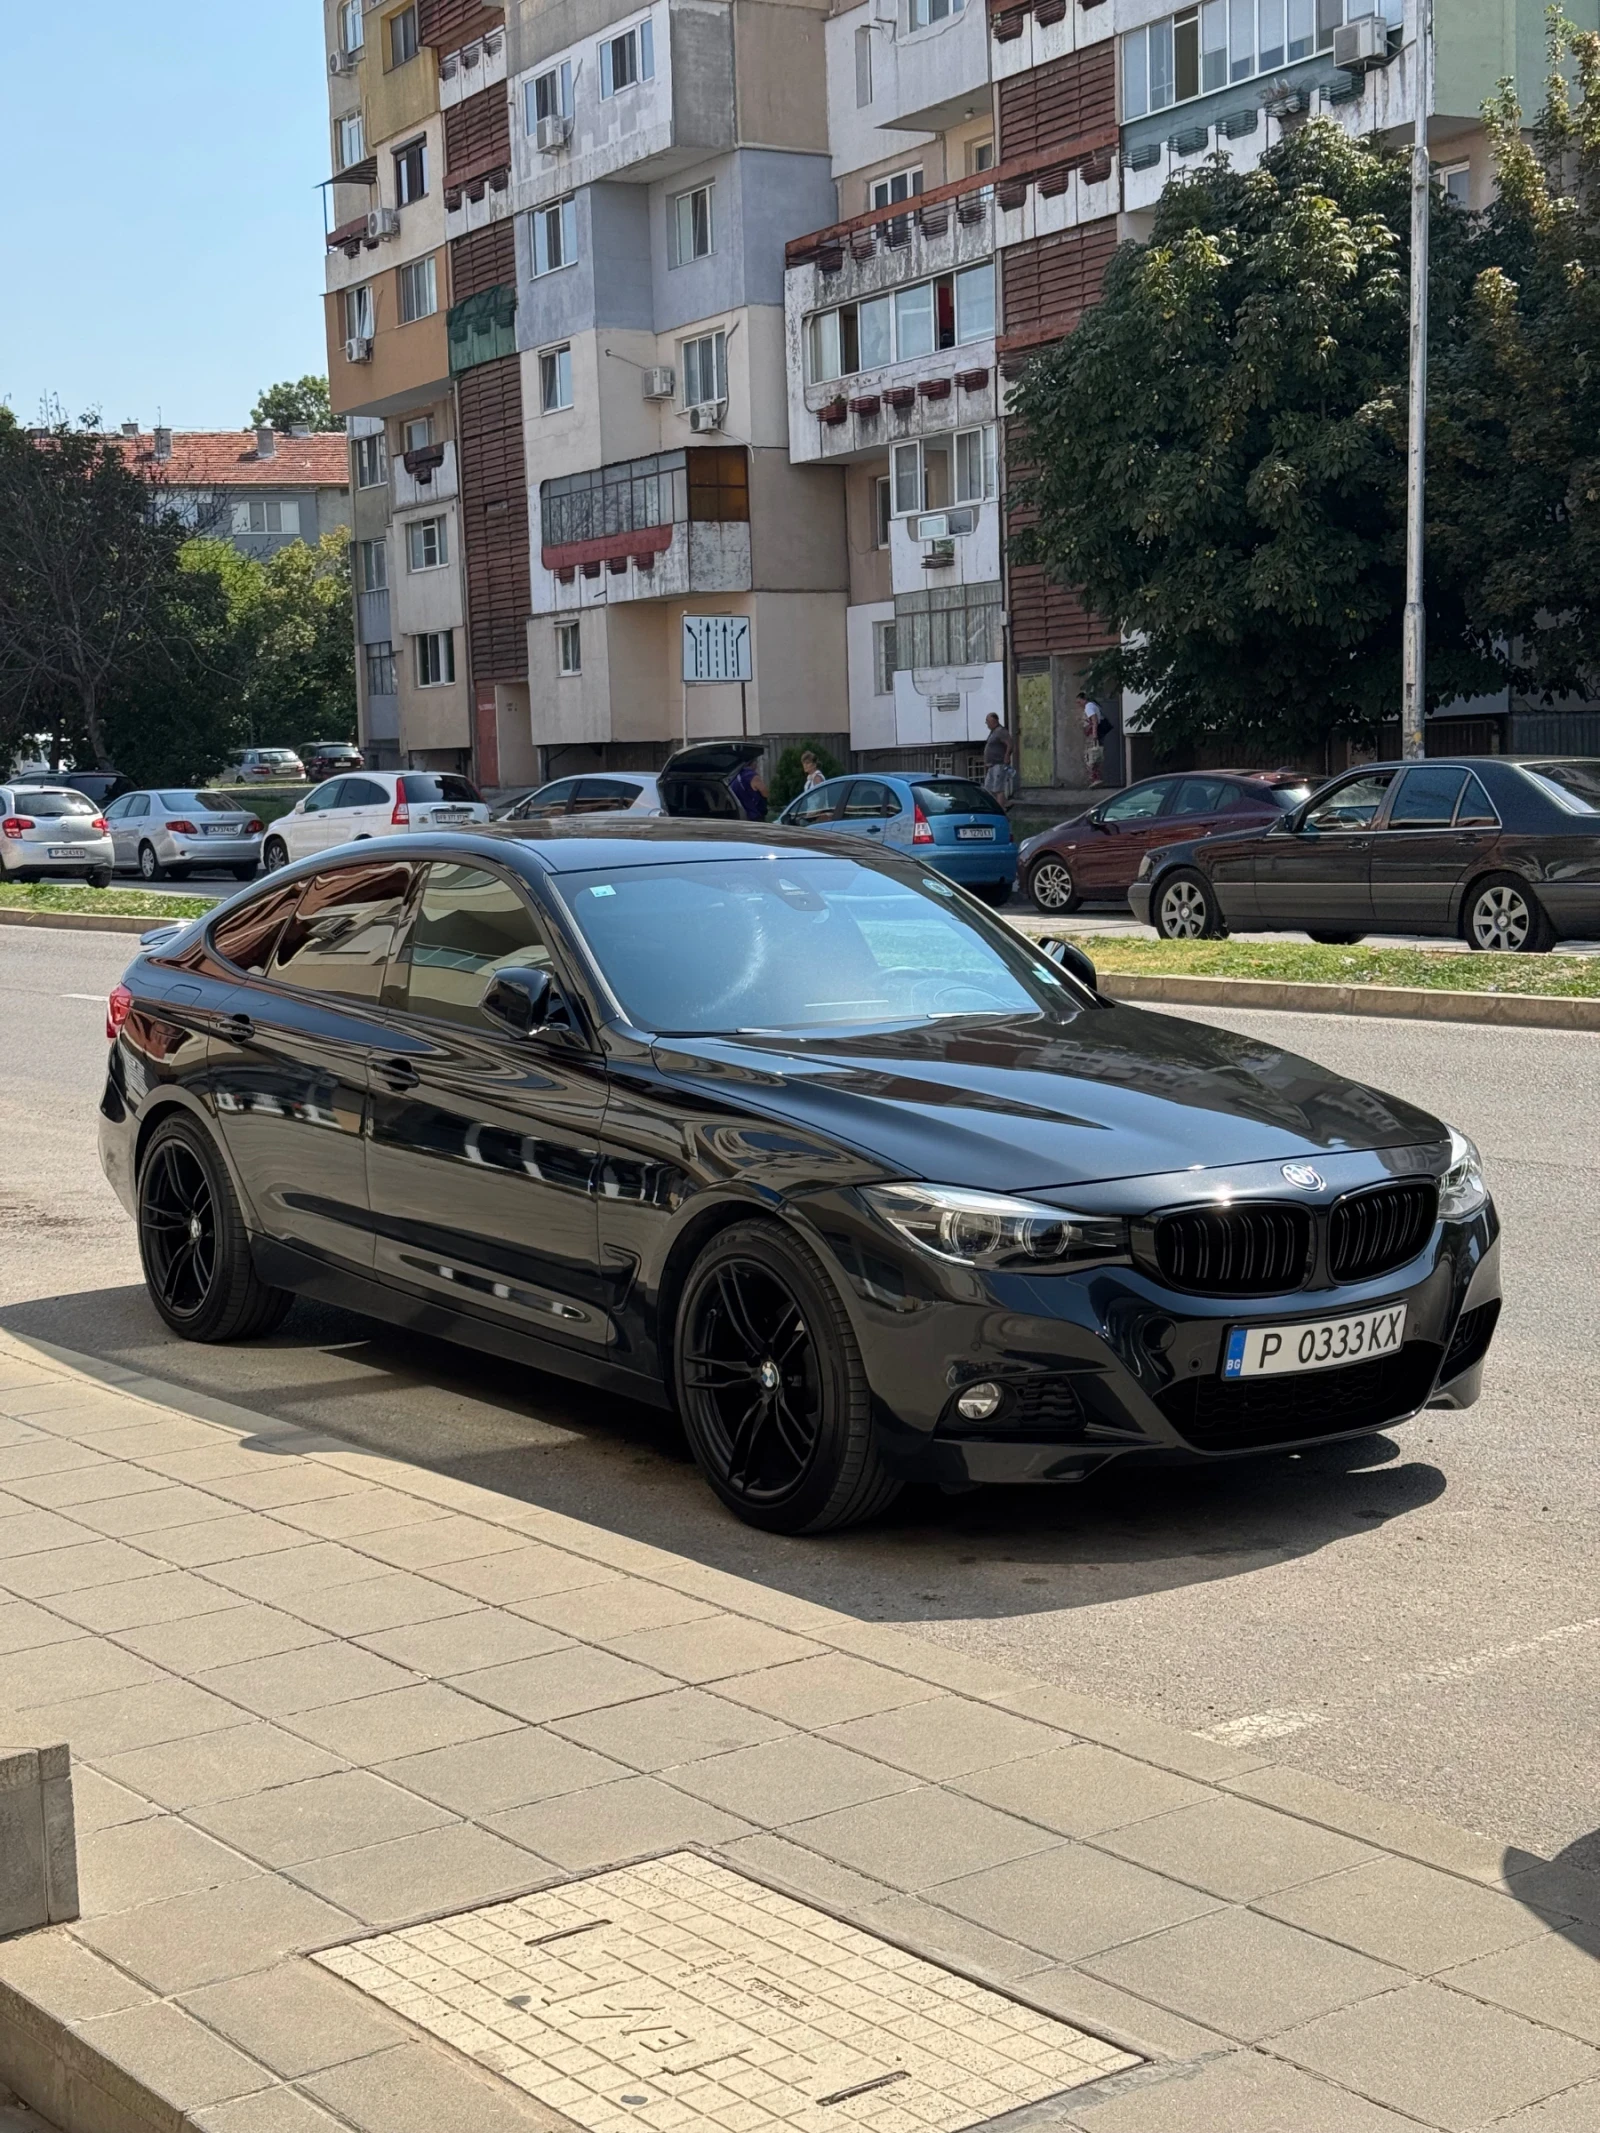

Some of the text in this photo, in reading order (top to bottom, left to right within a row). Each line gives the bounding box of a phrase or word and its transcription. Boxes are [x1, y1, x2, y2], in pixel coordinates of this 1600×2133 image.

[1258, 1310, 1402, 1369] P 0333KX
[1226, 1359, 1241, 1370] BG
